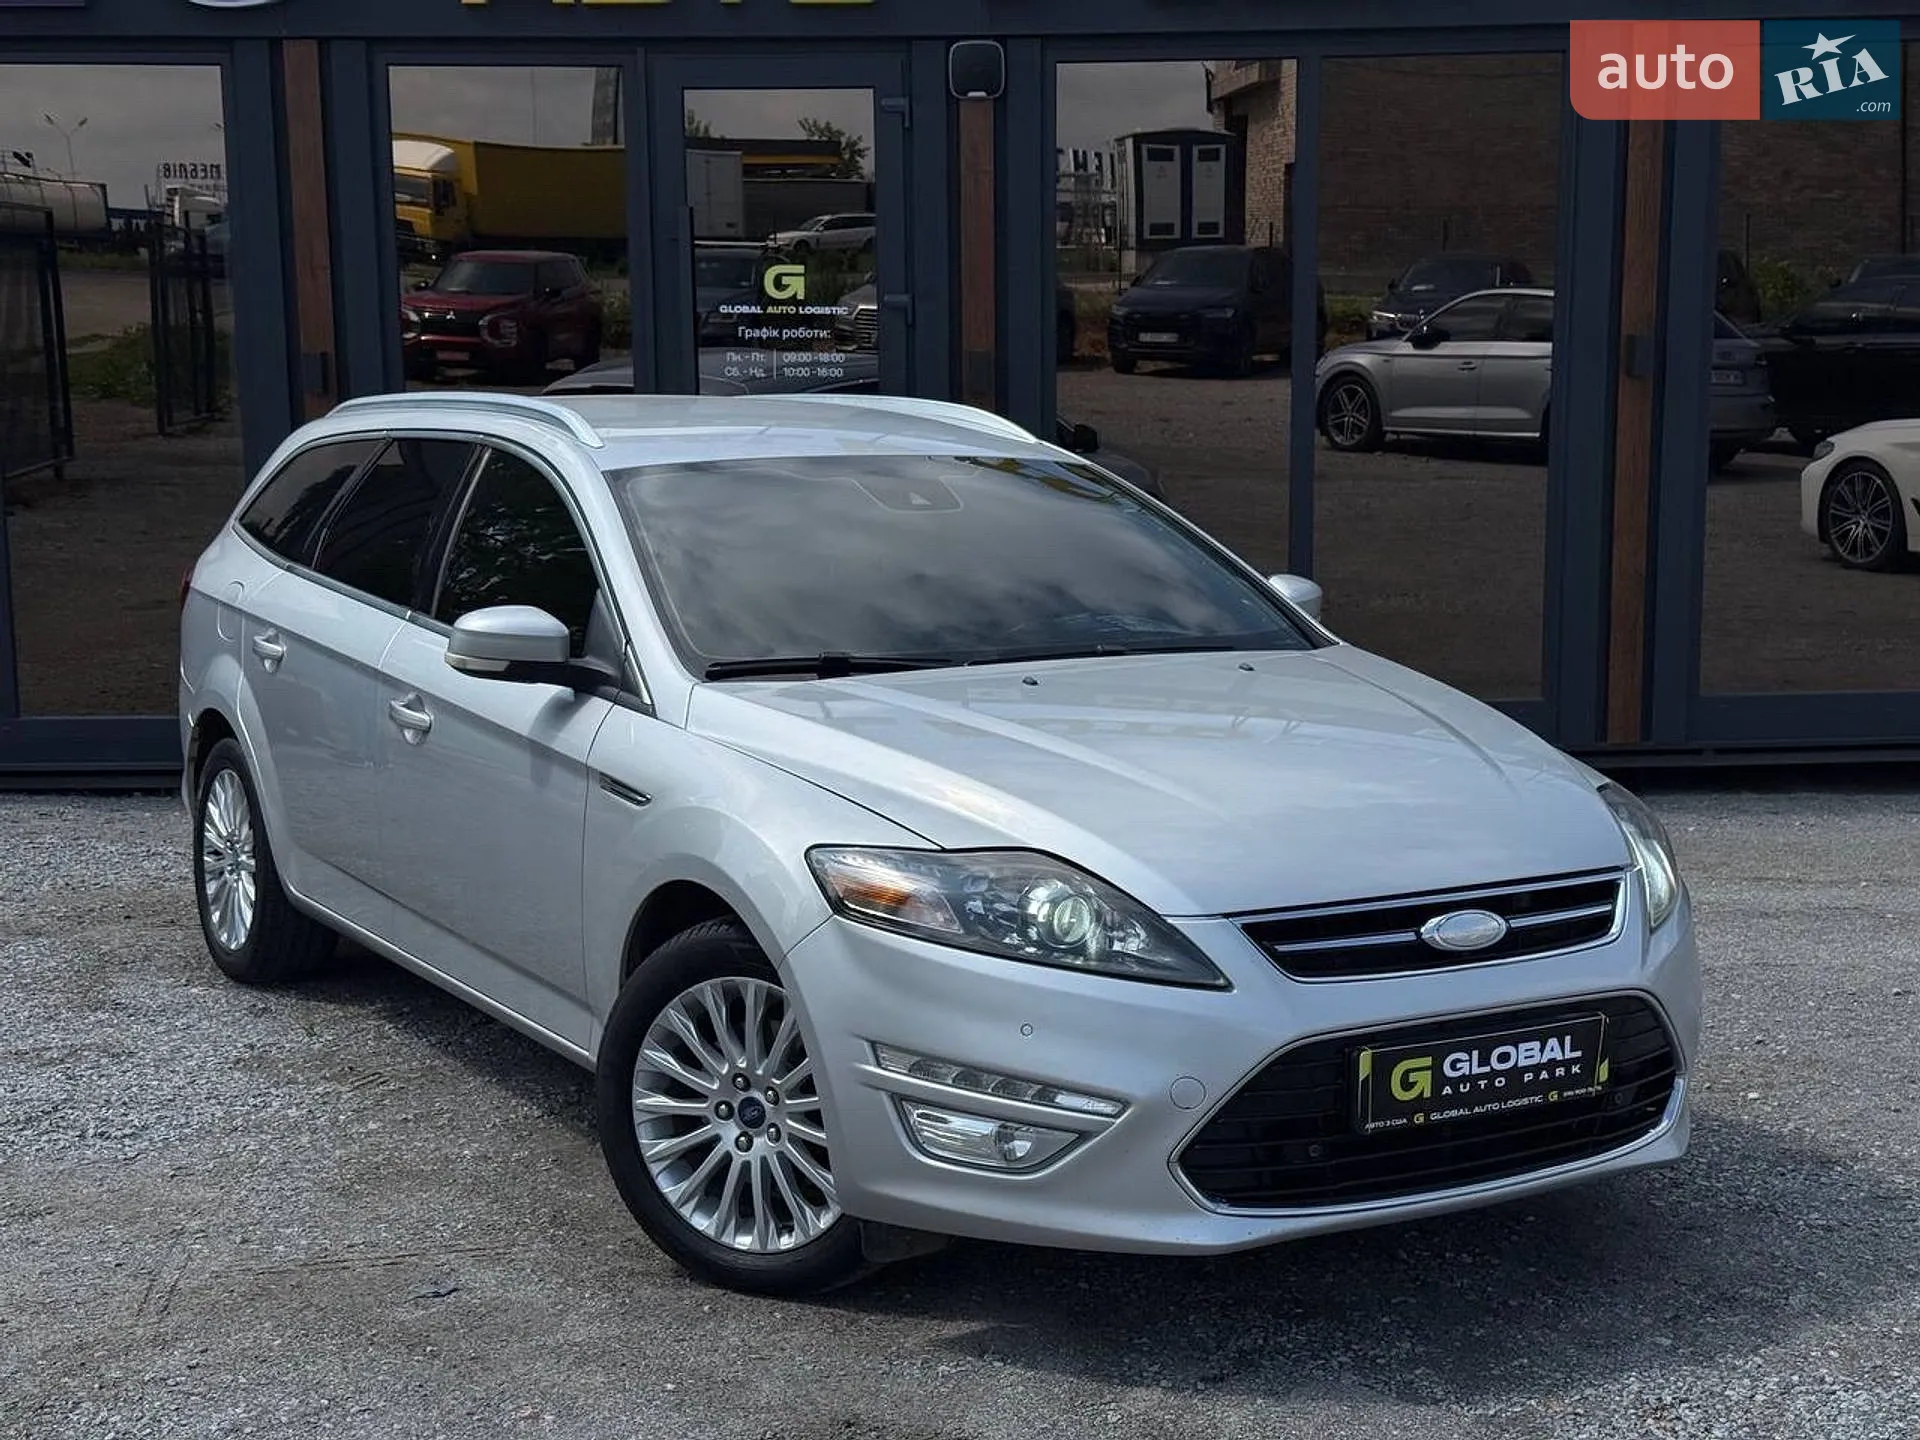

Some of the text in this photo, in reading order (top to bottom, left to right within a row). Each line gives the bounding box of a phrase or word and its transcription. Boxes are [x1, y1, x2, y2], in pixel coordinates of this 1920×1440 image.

[719, 304, 849, 315] GLOBAL AUTO LOGISTIC
[737, 326, 832, 340] Графік роботи:
[1442, 1034, 1583, 1078] GLOBAL
[1441, 1063, 1584, 1096] AUTO PARK
[1430, 1106, 1471, 1121] GLOBAL
[1472, 1102, 1500, 1114] AUTO
[1501, 1094, 1544, 1110] LOGISTIC
